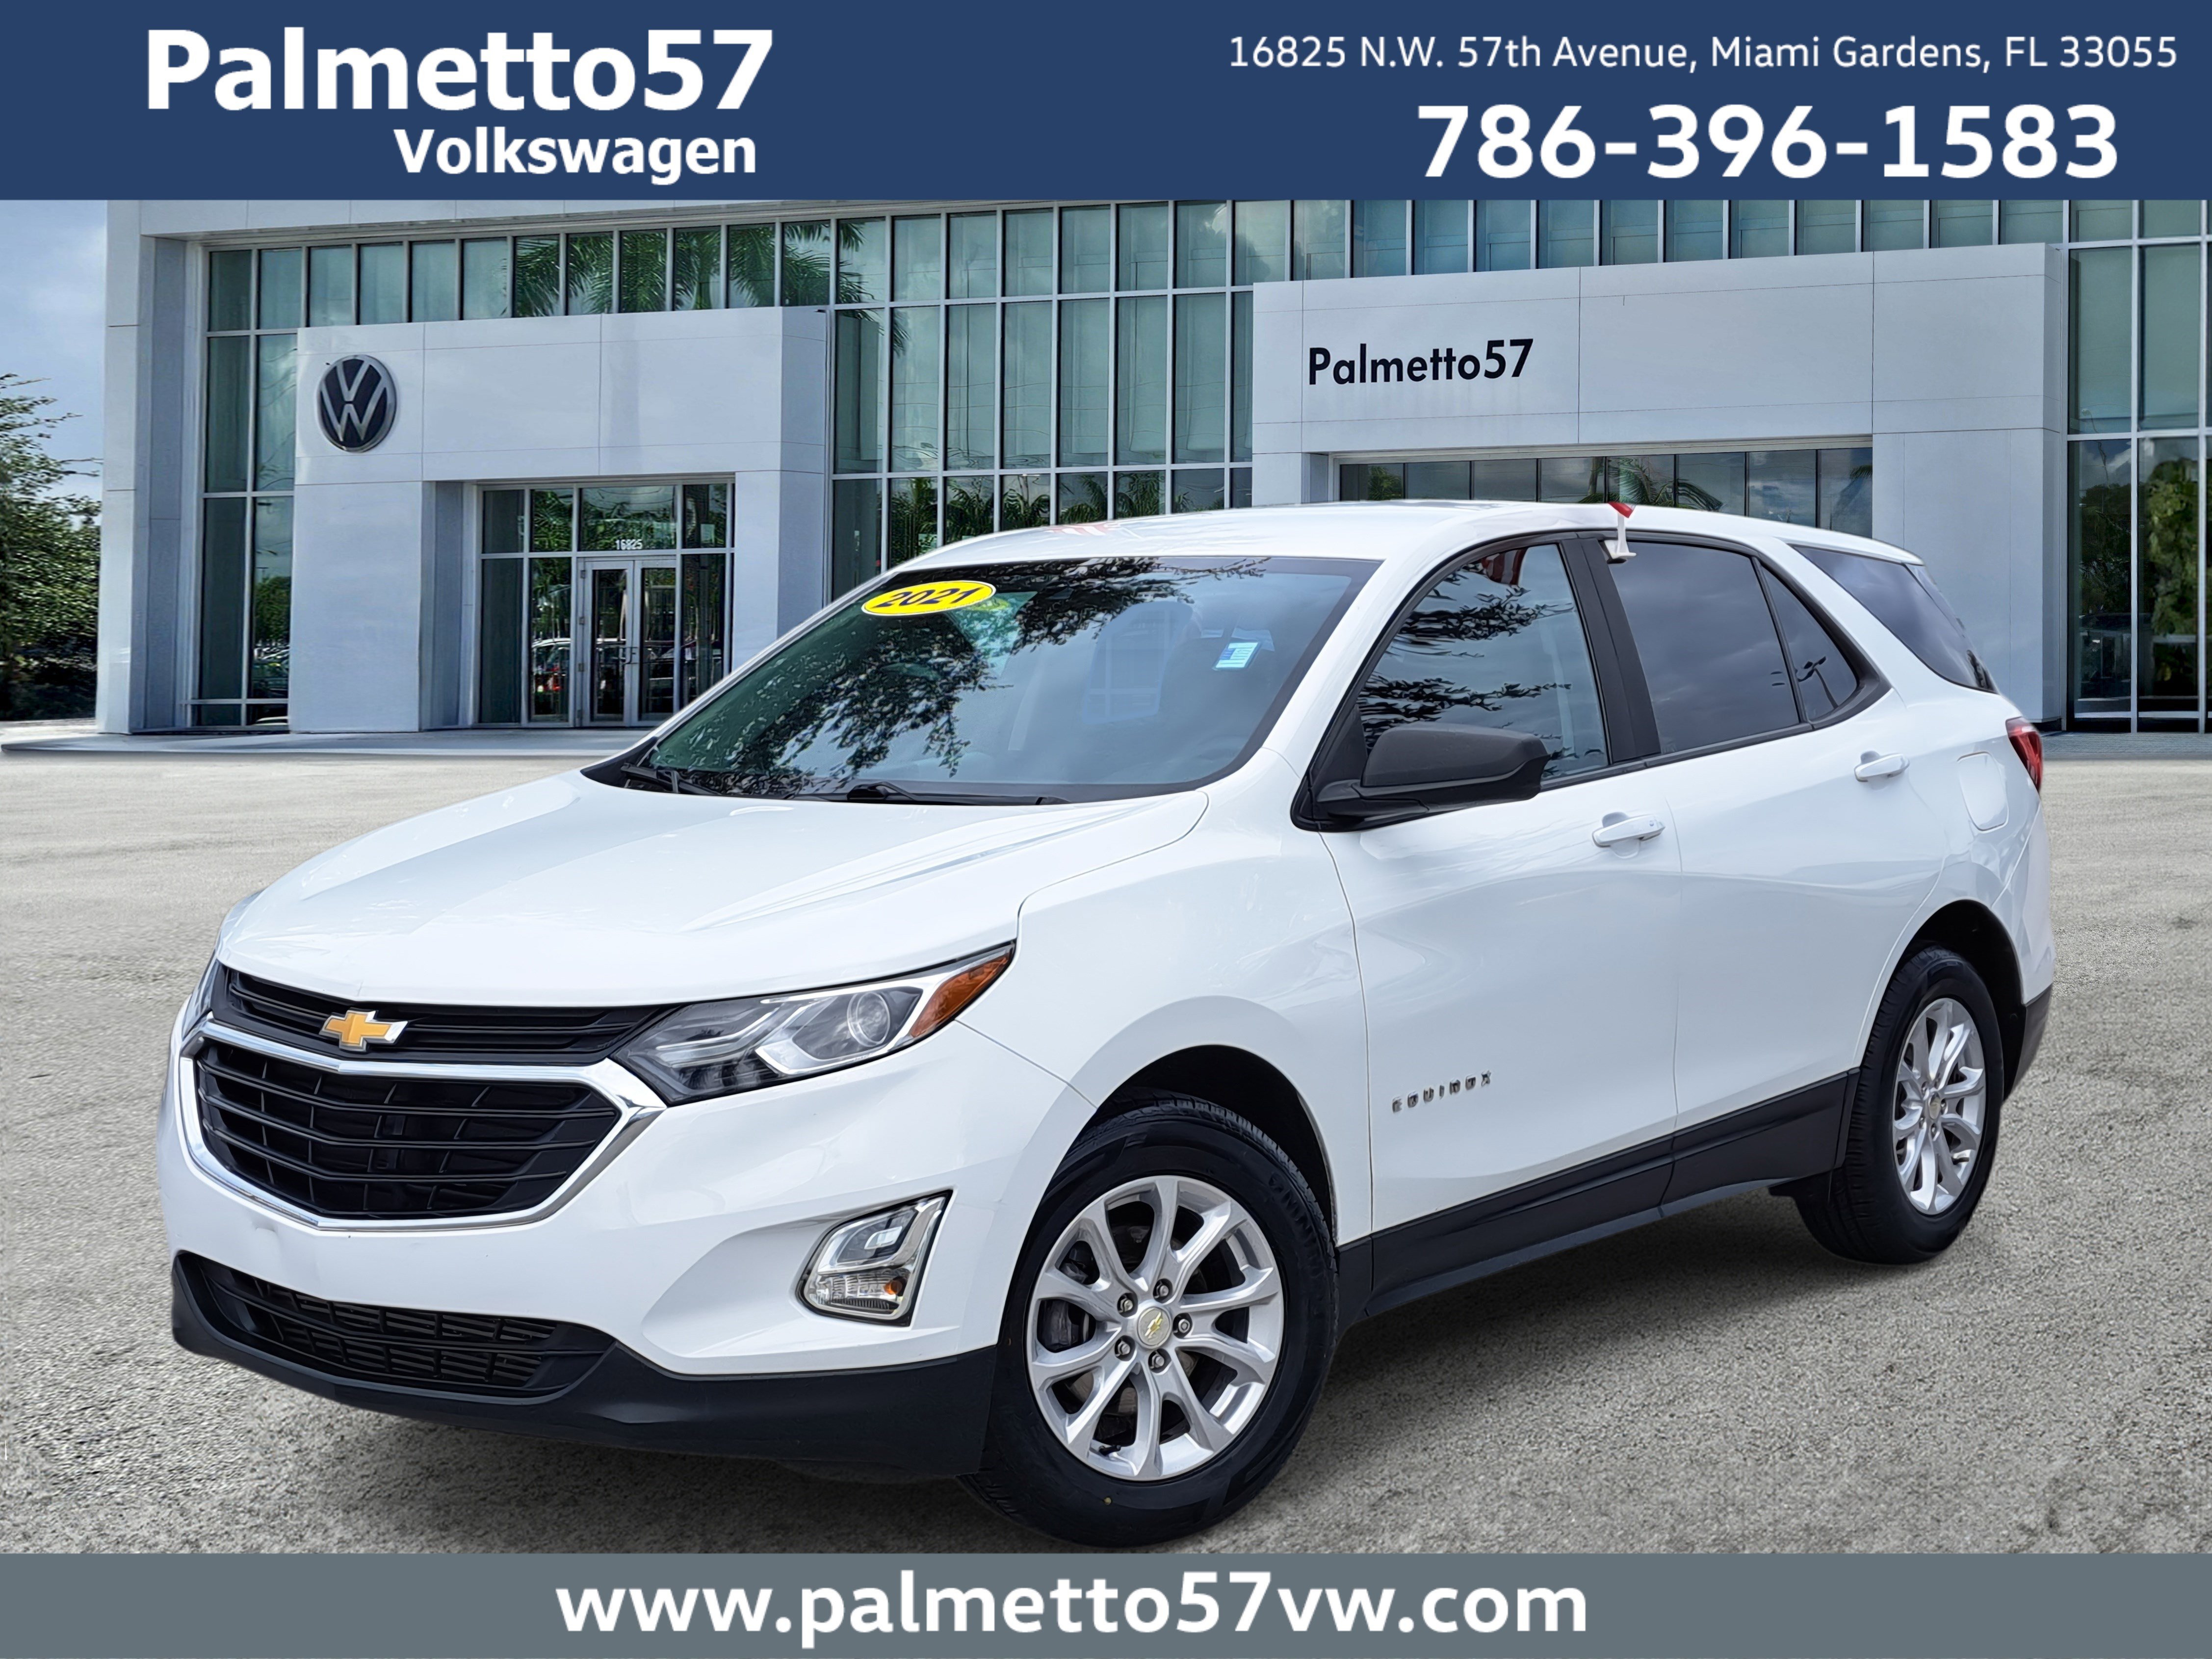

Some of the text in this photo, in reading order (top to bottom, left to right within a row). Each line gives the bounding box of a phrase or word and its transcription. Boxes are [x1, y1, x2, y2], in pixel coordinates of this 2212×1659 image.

[1309, 338, 1534, 385] Palmetto57
[615, 539, 643, 550] 16825
[872, 587, 984, 608] 2021
[1392, 1069, 1491, 1114] EQUINOX
